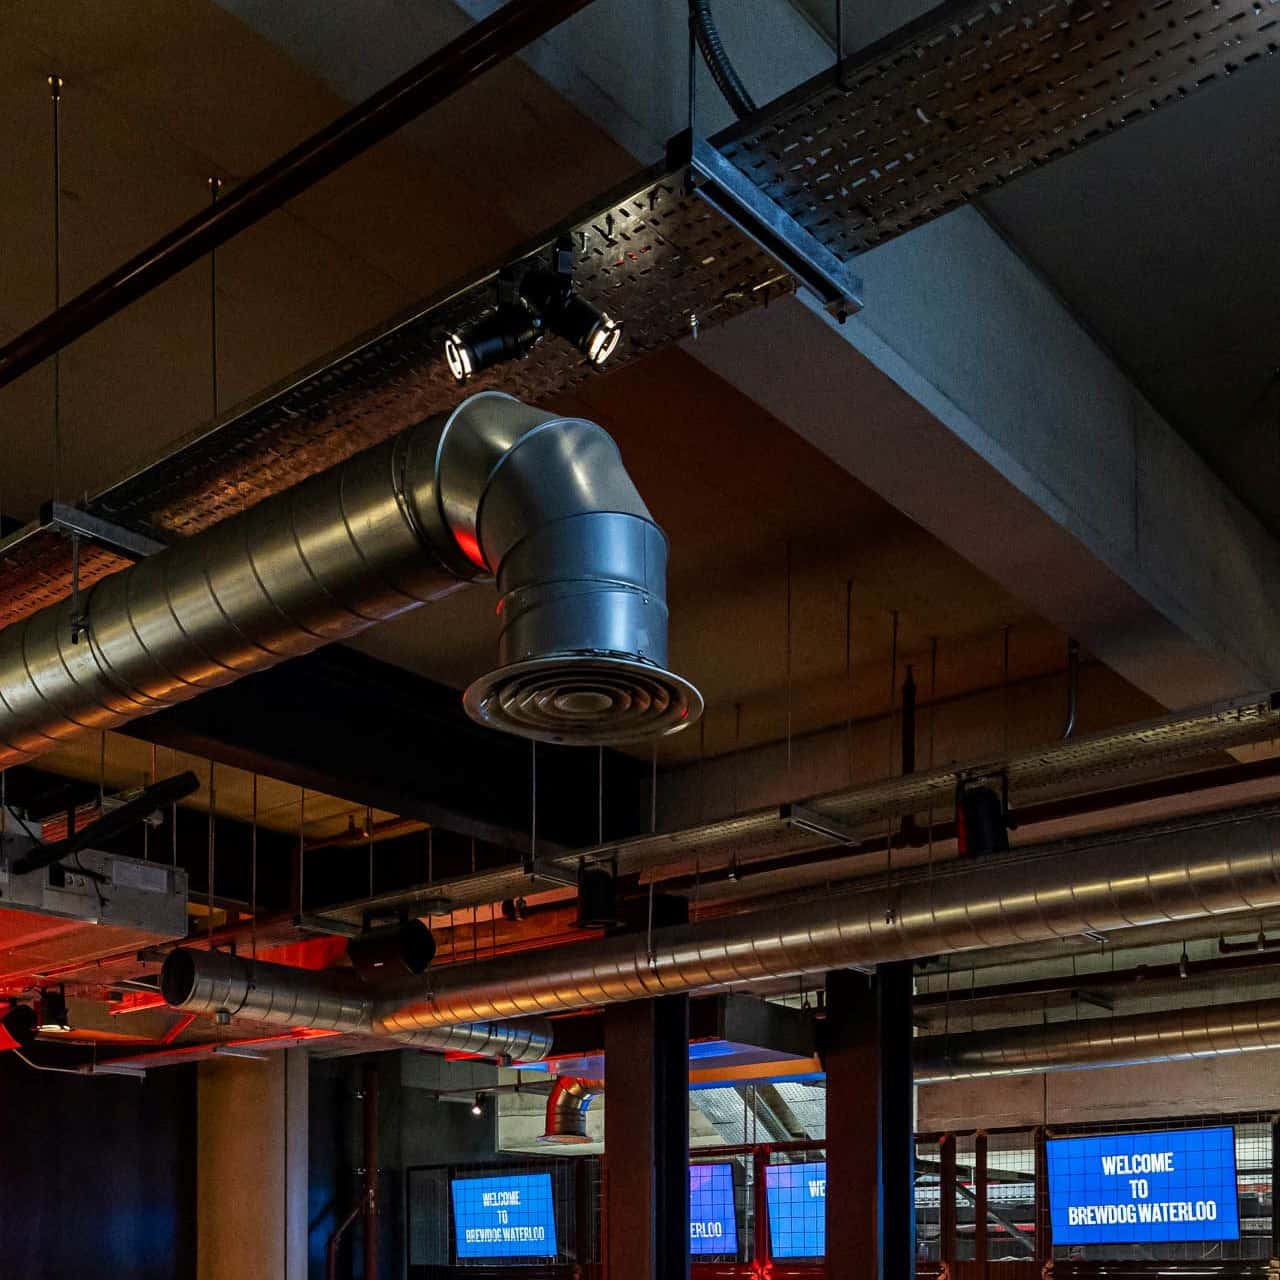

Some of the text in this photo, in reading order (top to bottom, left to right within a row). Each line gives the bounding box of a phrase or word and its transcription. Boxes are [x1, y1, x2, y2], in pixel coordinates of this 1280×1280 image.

[1101, 1152, 1175, 1176] WELCOME
[1128, 1179, 1149, 1199] TO
[482, 1191, 521, 1208] WELCOME
[496, 1210, 509, 1225] TO
[1068, 1200, 1217, 1226] BREWDOG WATERLOO
[503, 1226, 545, 1242] WATERLOO
[689, 1221, 723, 1239] ERLOO
